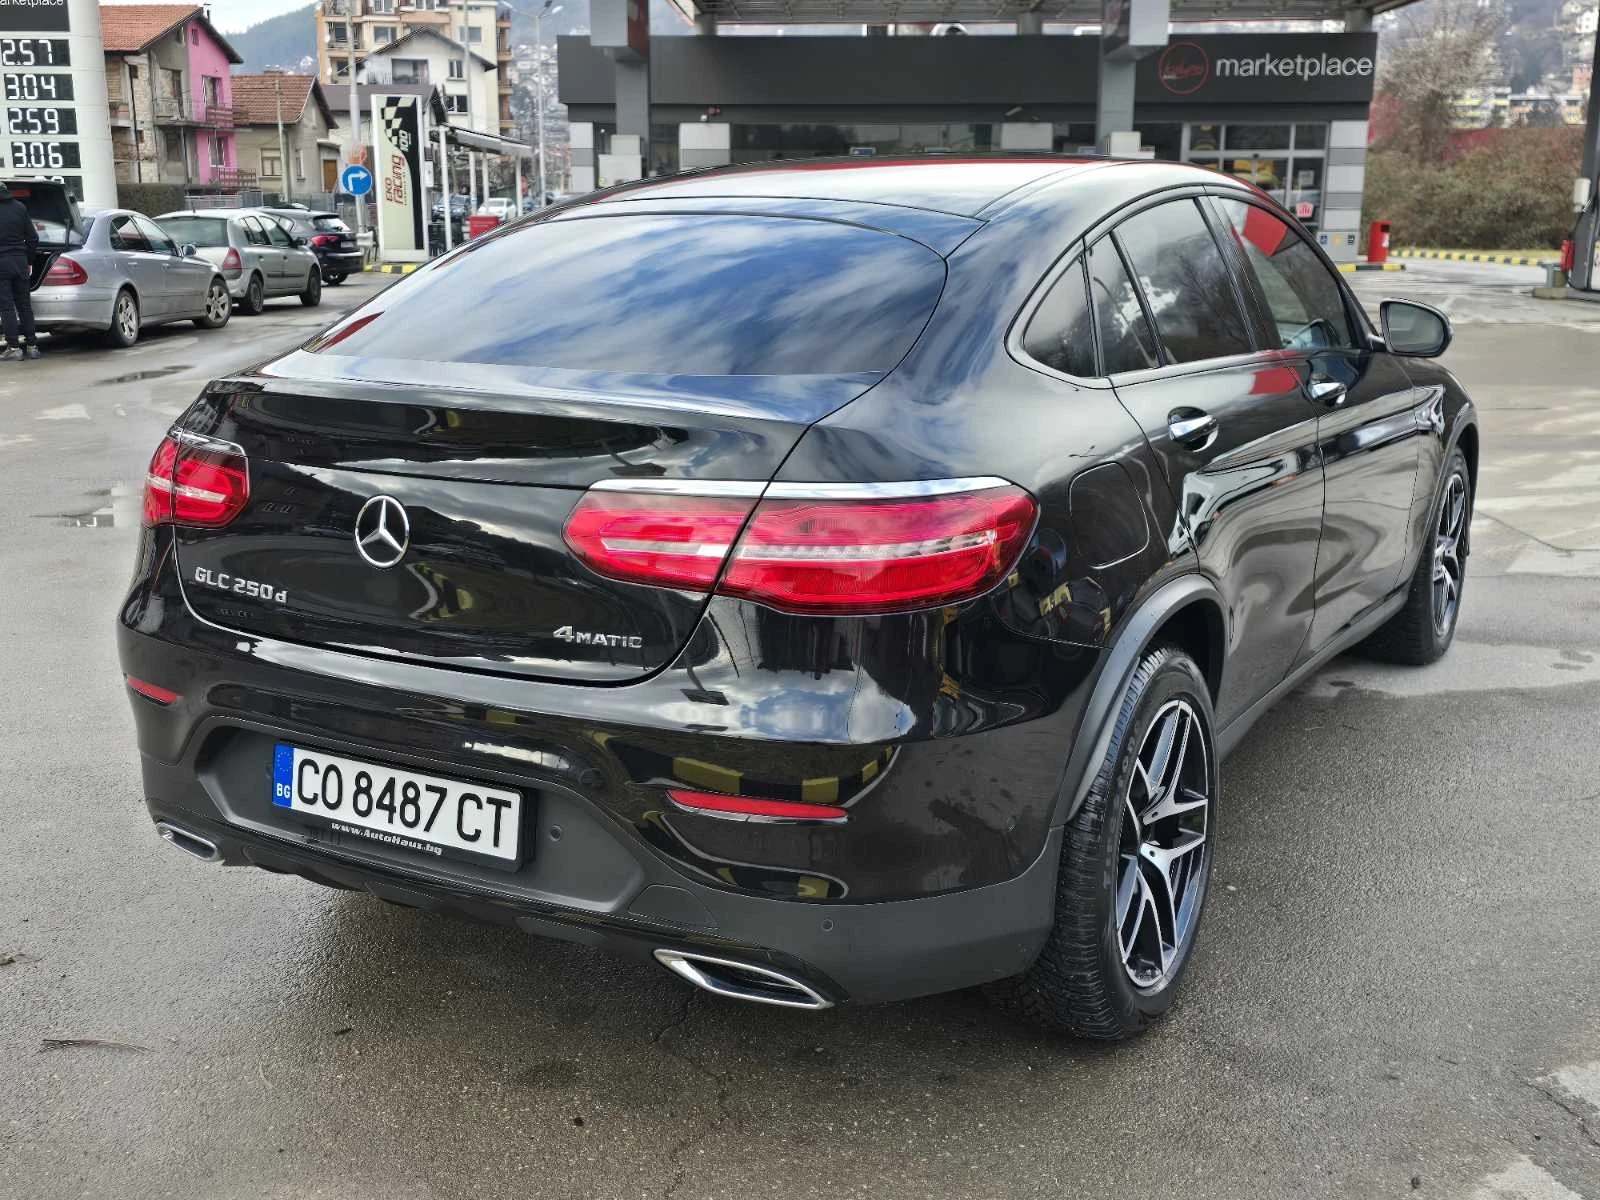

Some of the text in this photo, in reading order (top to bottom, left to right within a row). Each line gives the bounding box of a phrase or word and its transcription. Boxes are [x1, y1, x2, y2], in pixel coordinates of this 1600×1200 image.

[2, 39, 53, 66] 2.57
[1215, 52, 1373, 81] marketplace
[6, 74, 56, 100] 3.04
[9, 108, 60, 134] 2.59
[13, 142, 63, 168] 3.06
[392, 154, 405, 206] racing
[195, 566, 230, 589] GLC
[553, 625, 643, 648] 4MATIC
[276, 782, 291, 799] BG
[297, 758, 512, 848] CO 8487 CT
[331, 822, 442, 856] www.AutoHaus.bg
